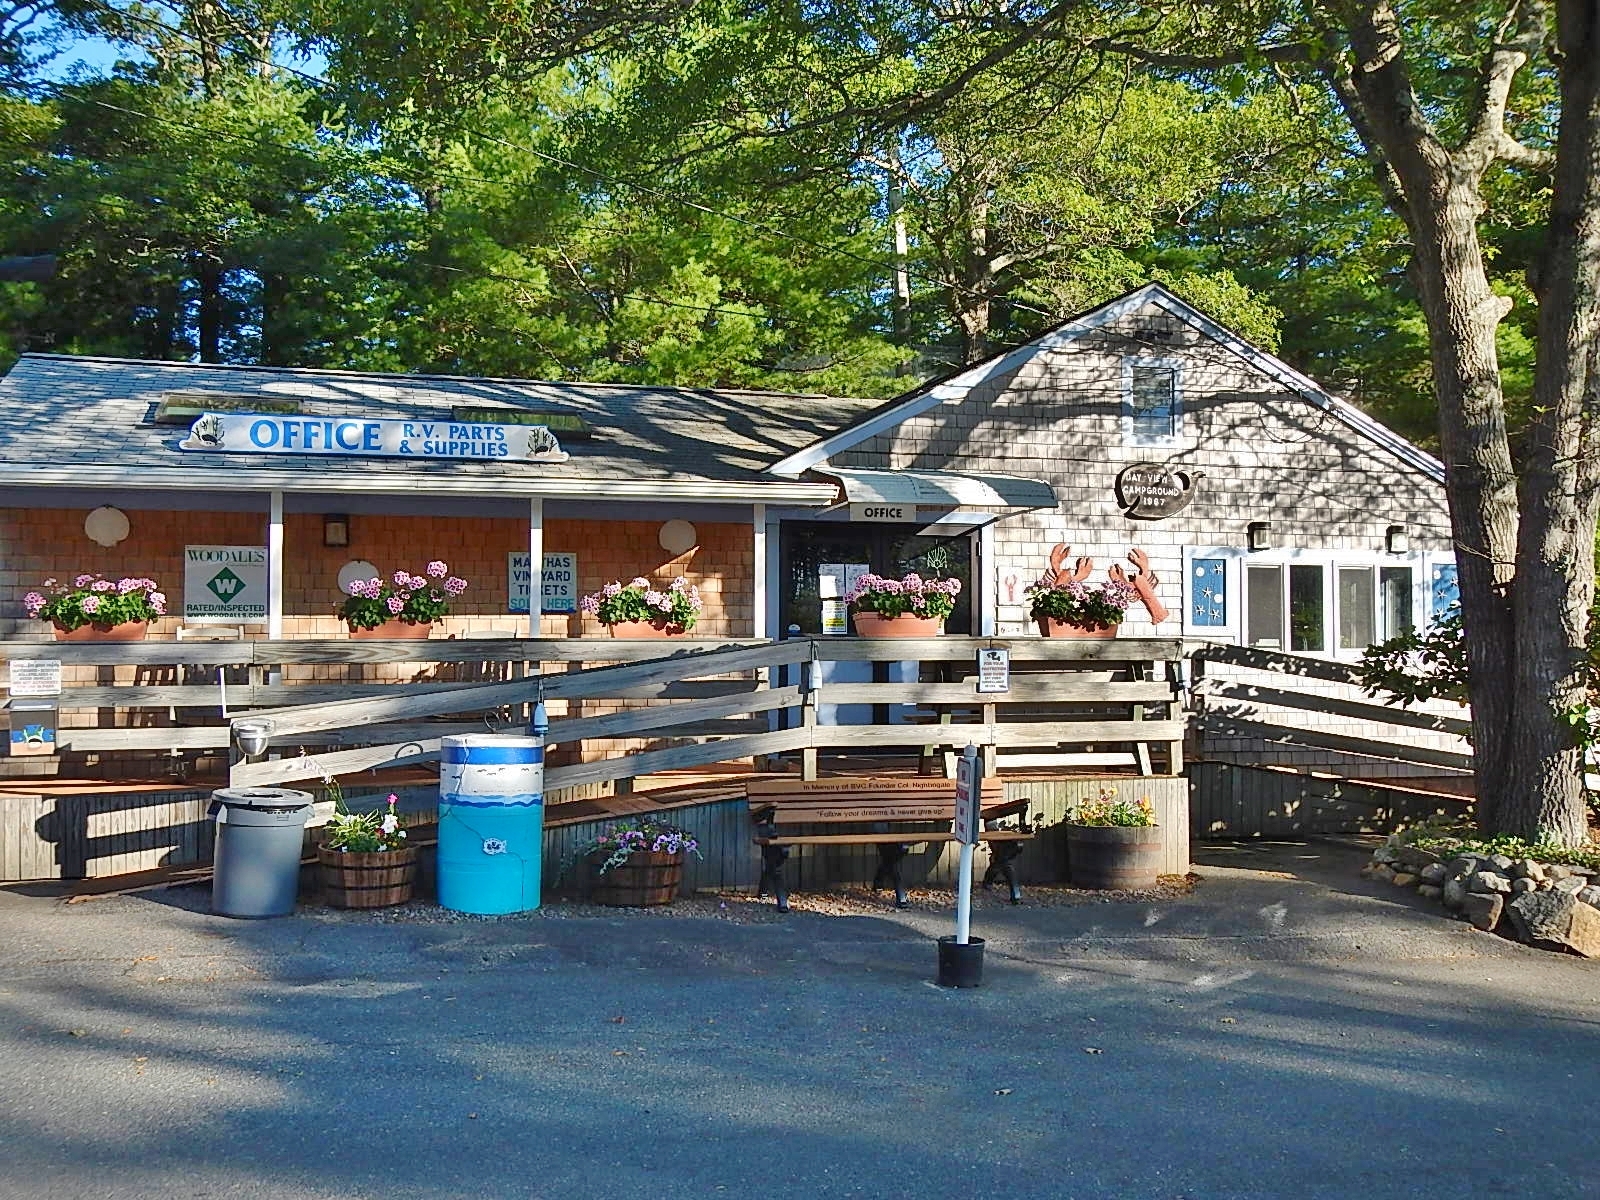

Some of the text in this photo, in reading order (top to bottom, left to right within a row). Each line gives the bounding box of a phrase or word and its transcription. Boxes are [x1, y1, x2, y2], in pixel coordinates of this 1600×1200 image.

[249, 419, 383, 451] OFFICE
[403, 423, 506, 441] R.V. PARTS
[399, 439, 509, 457] & SUPPLIES
[1121, 485, 1180, 497] CAMPGROUND
[864, 507, 903, 519] OFFICE
[513, 570, 571, 582] VINYARD
[517, 584, 568, 596] TIETS
[186, 604, 265, 612] RATED/INSPECTED
[547, 598, 574, 609] HERE
